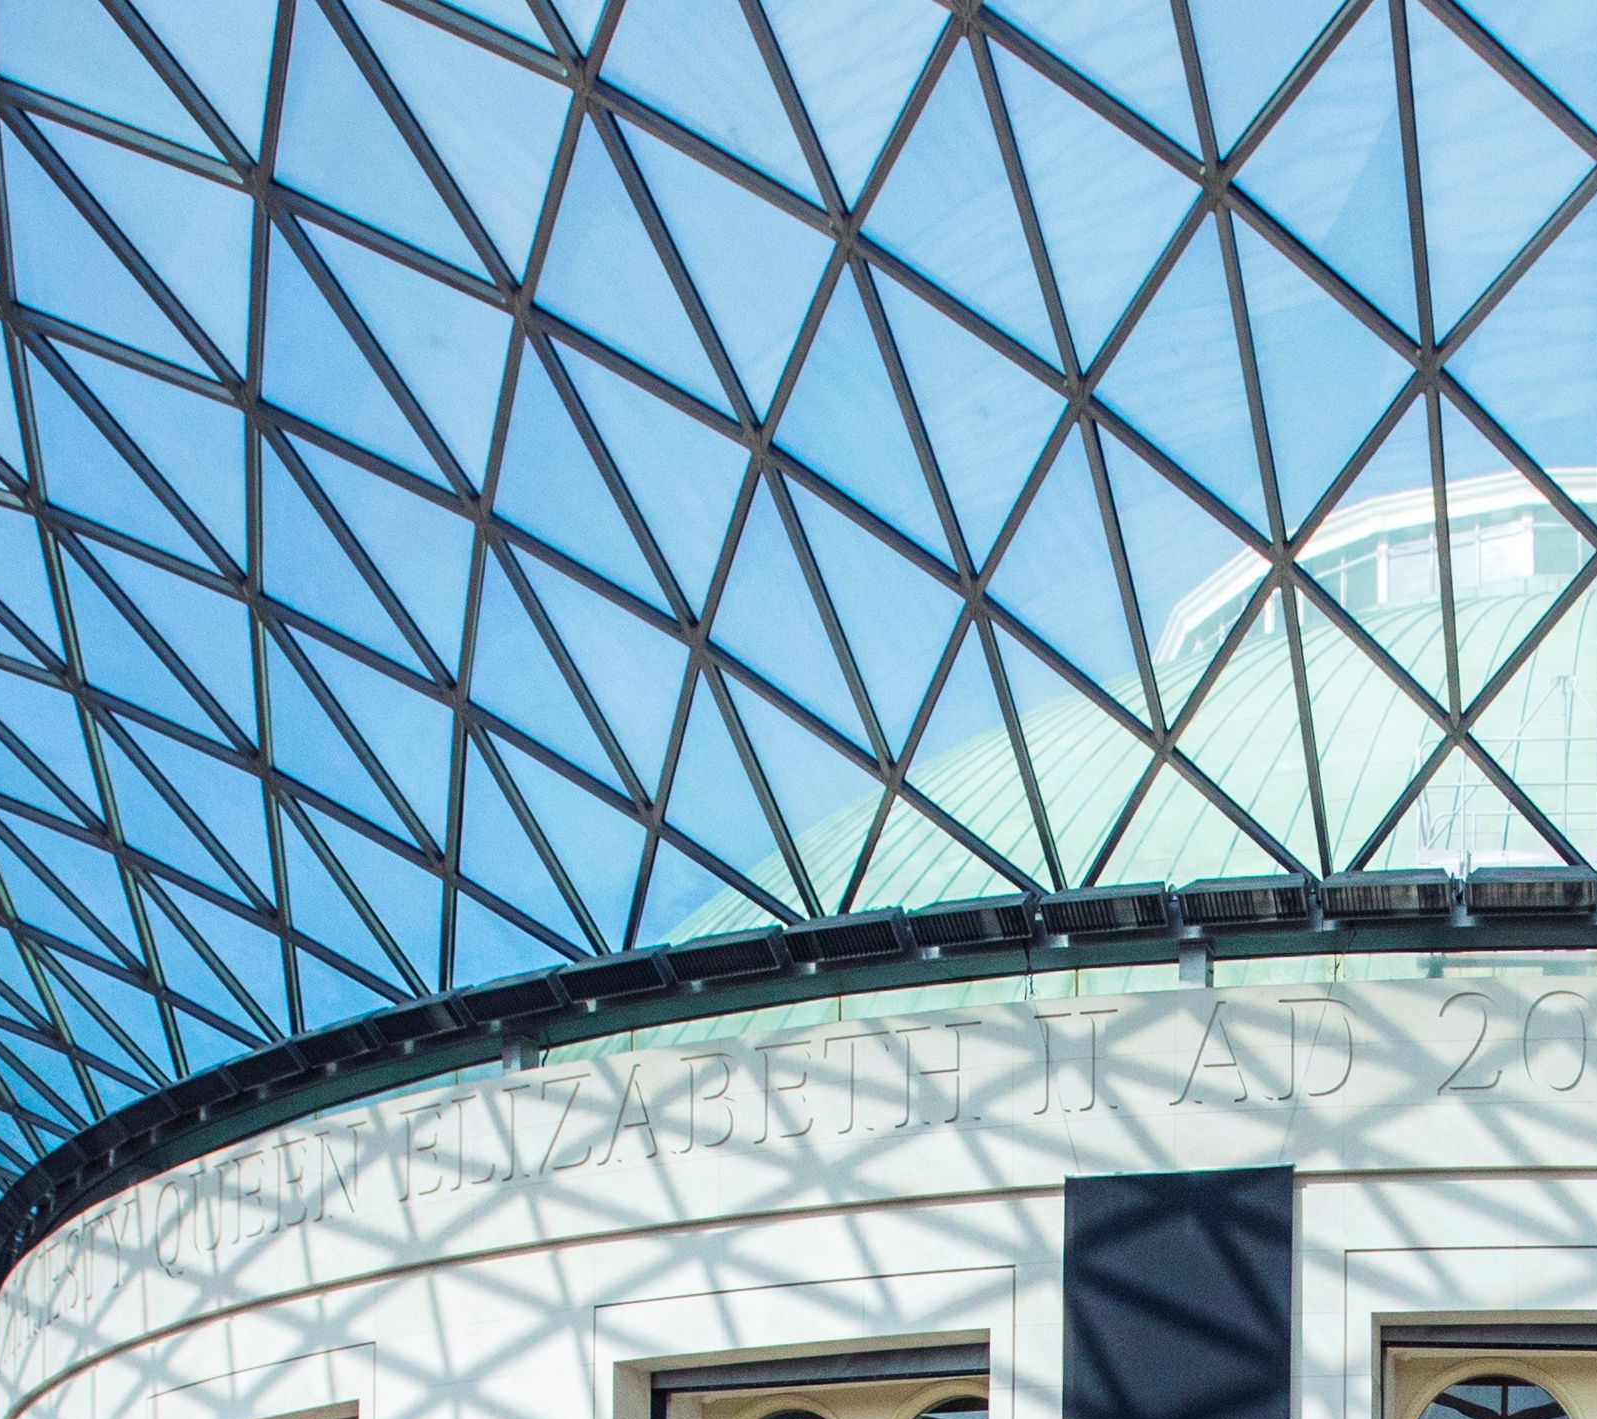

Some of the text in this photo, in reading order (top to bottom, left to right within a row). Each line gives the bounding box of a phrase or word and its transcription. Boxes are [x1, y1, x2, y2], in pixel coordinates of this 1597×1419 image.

[154, 1120, 368, 1278] QUEEN
[398, 1021, 981, 1203] ELIZABETH
[1033, 1009, 1118, 1115] II
[1168, 998, 1360, 1106] AD
